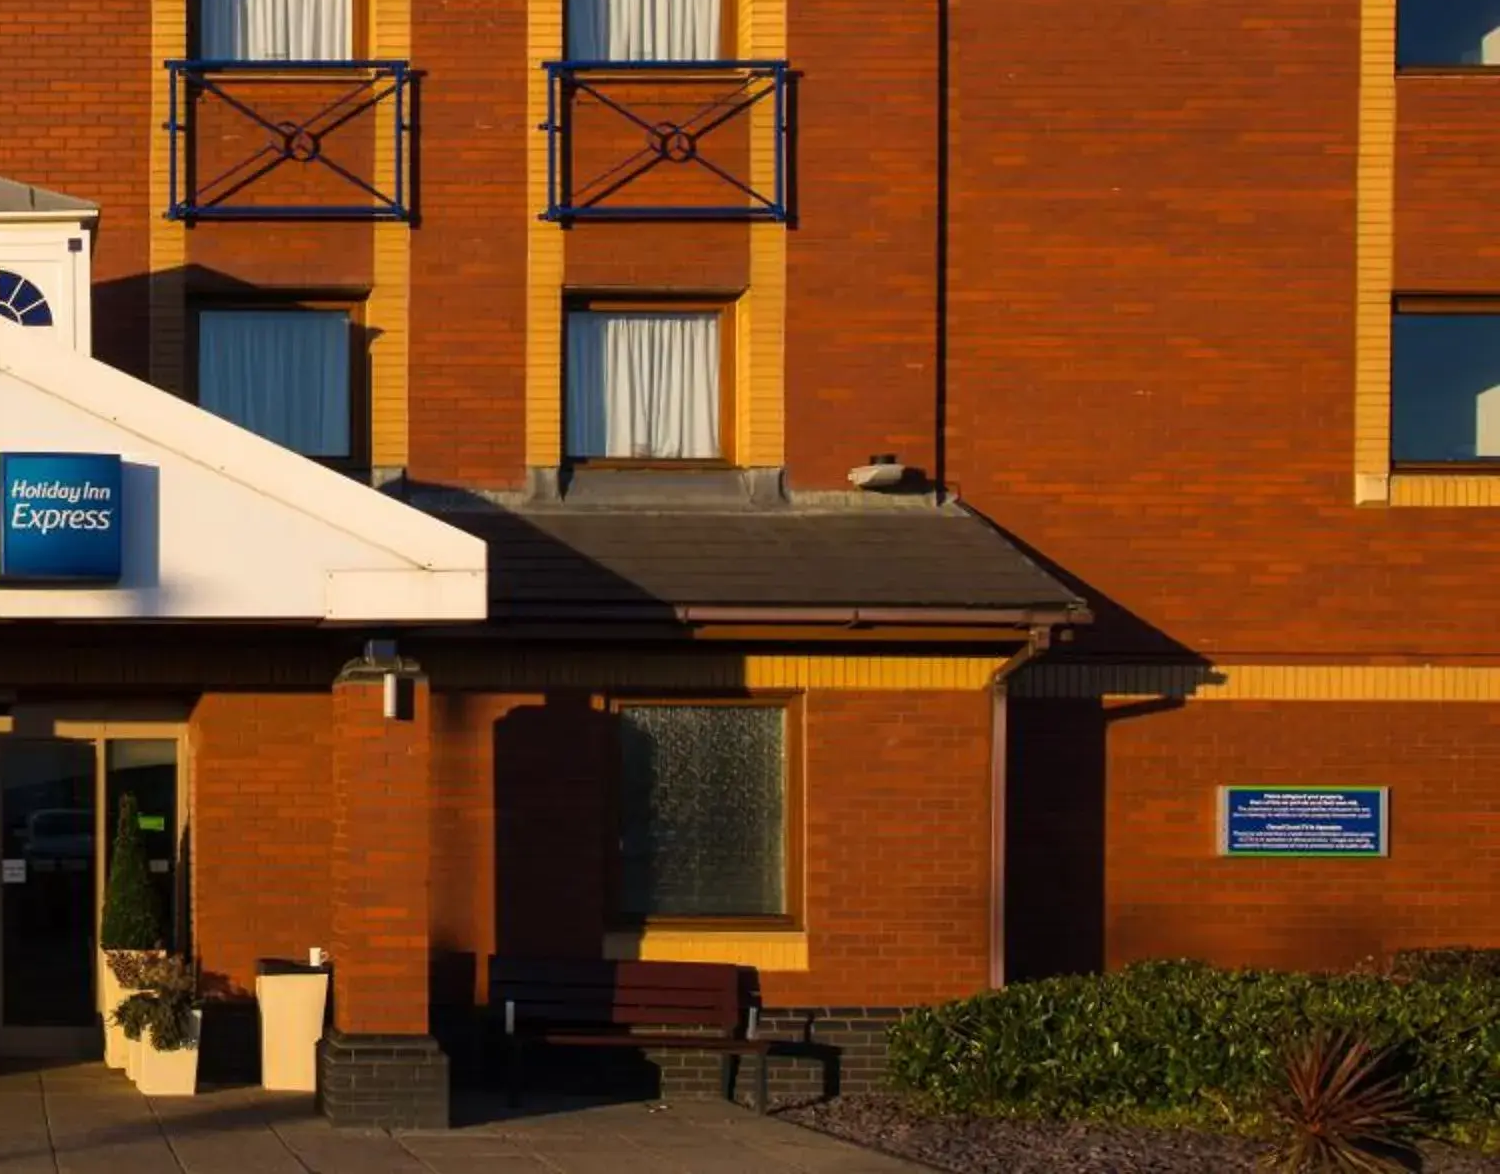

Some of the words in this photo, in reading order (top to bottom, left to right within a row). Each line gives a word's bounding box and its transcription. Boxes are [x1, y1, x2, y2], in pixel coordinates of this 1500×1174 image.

[11, 479, 82, 502] Holiday
[83, 481, 111, 500] Inn
[11, 503, 112, 535] Express
